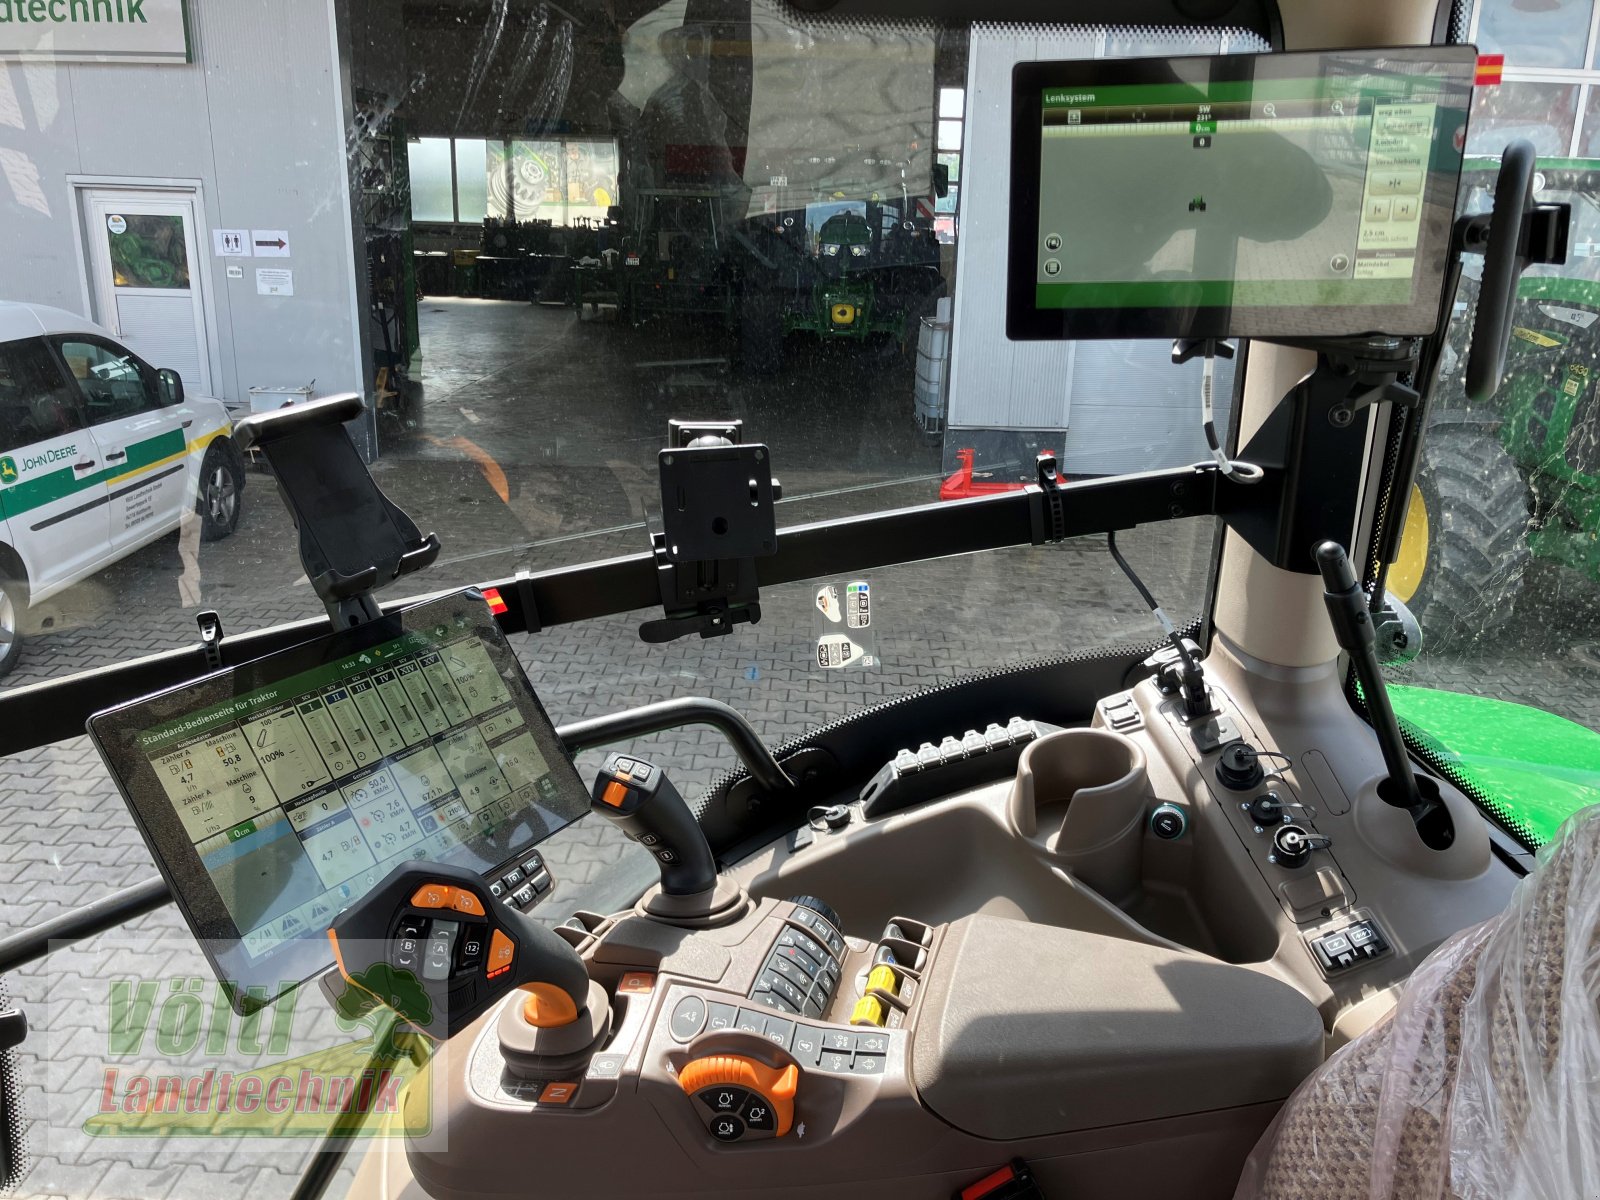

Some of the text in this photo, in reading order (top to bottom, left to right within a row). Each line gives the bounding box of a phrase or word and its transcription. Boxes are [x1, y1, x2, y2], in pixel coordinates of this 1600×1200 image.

[0, 0, 147, 23] dtechnik
[1045, 93, 1096, 104] Lenksystem
[1199, 138, 1205, 146] 0
[22, 444, 78, 472] JOHN DEERE
[424, 655, 435, 665] XV
[400, 664, 415, 676] XIV
[379, 674, 389, 683] IV
[456, 674, 475, 684] 100%
[143, 690, 278, 745] Standard-Bedienseite für Traktor
[260, 718, 272, 727] 100
[205, 732, 237, 747] Maschine
[162, 751, 184, 764] Zähler
[223, 754, 242, 767] 50,8
[260, 749, 285, 764] 100%
[181, 772, 193, 784] 4,7
[226, 770, 257, 787] Maschine
[368, 775, 386, 790] 50,0
[182, 792, 205, 806] Zähler
[249, 795, 256, 804] 9
[386, 799, 400, 811] 7,6
[321, 802, 328, 811] 0
[399, 821, 411, 833] 4,7
[322, 850, 334, 862] 4,7
[404, 941, 413, 950] B
[468, 944, 477, 952] 12
